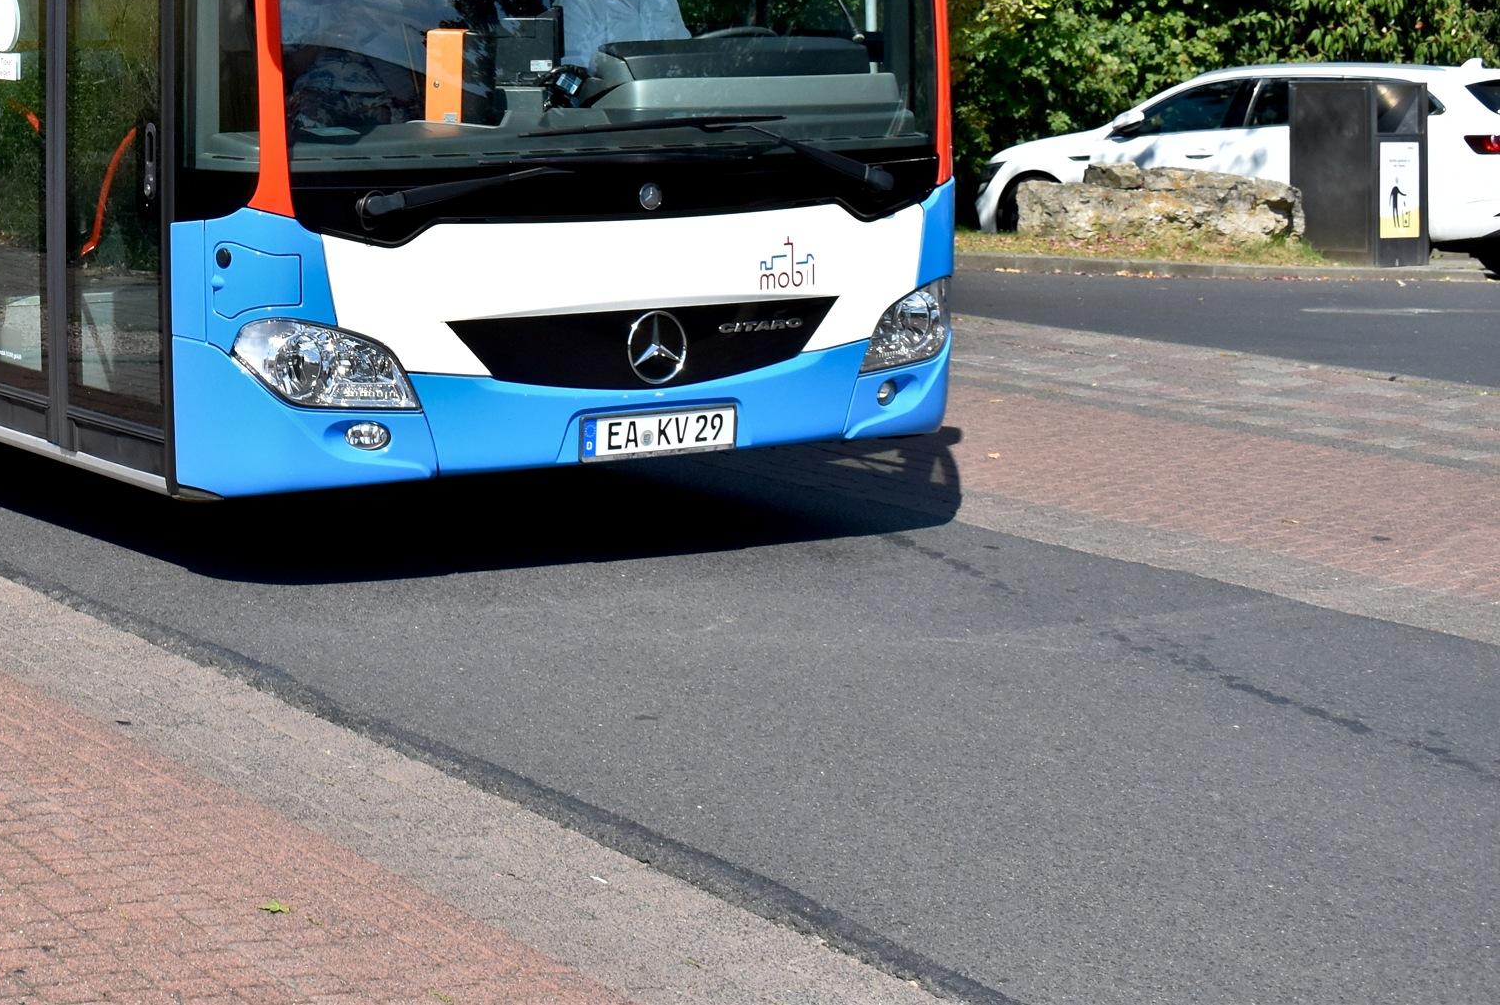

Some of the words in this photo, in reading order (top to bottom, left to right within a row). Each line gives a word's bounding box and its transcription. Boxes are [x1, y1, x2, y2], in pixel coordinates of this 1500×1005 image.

[760, 242, 815, 290] mobil
[718, 318, 803, 334] CITARO
[607, 420, 639, 450] EA
[657, 416, 689, 446] KV
[694, 413, 724, 443] 29
[586, 441, 593, 451] D
